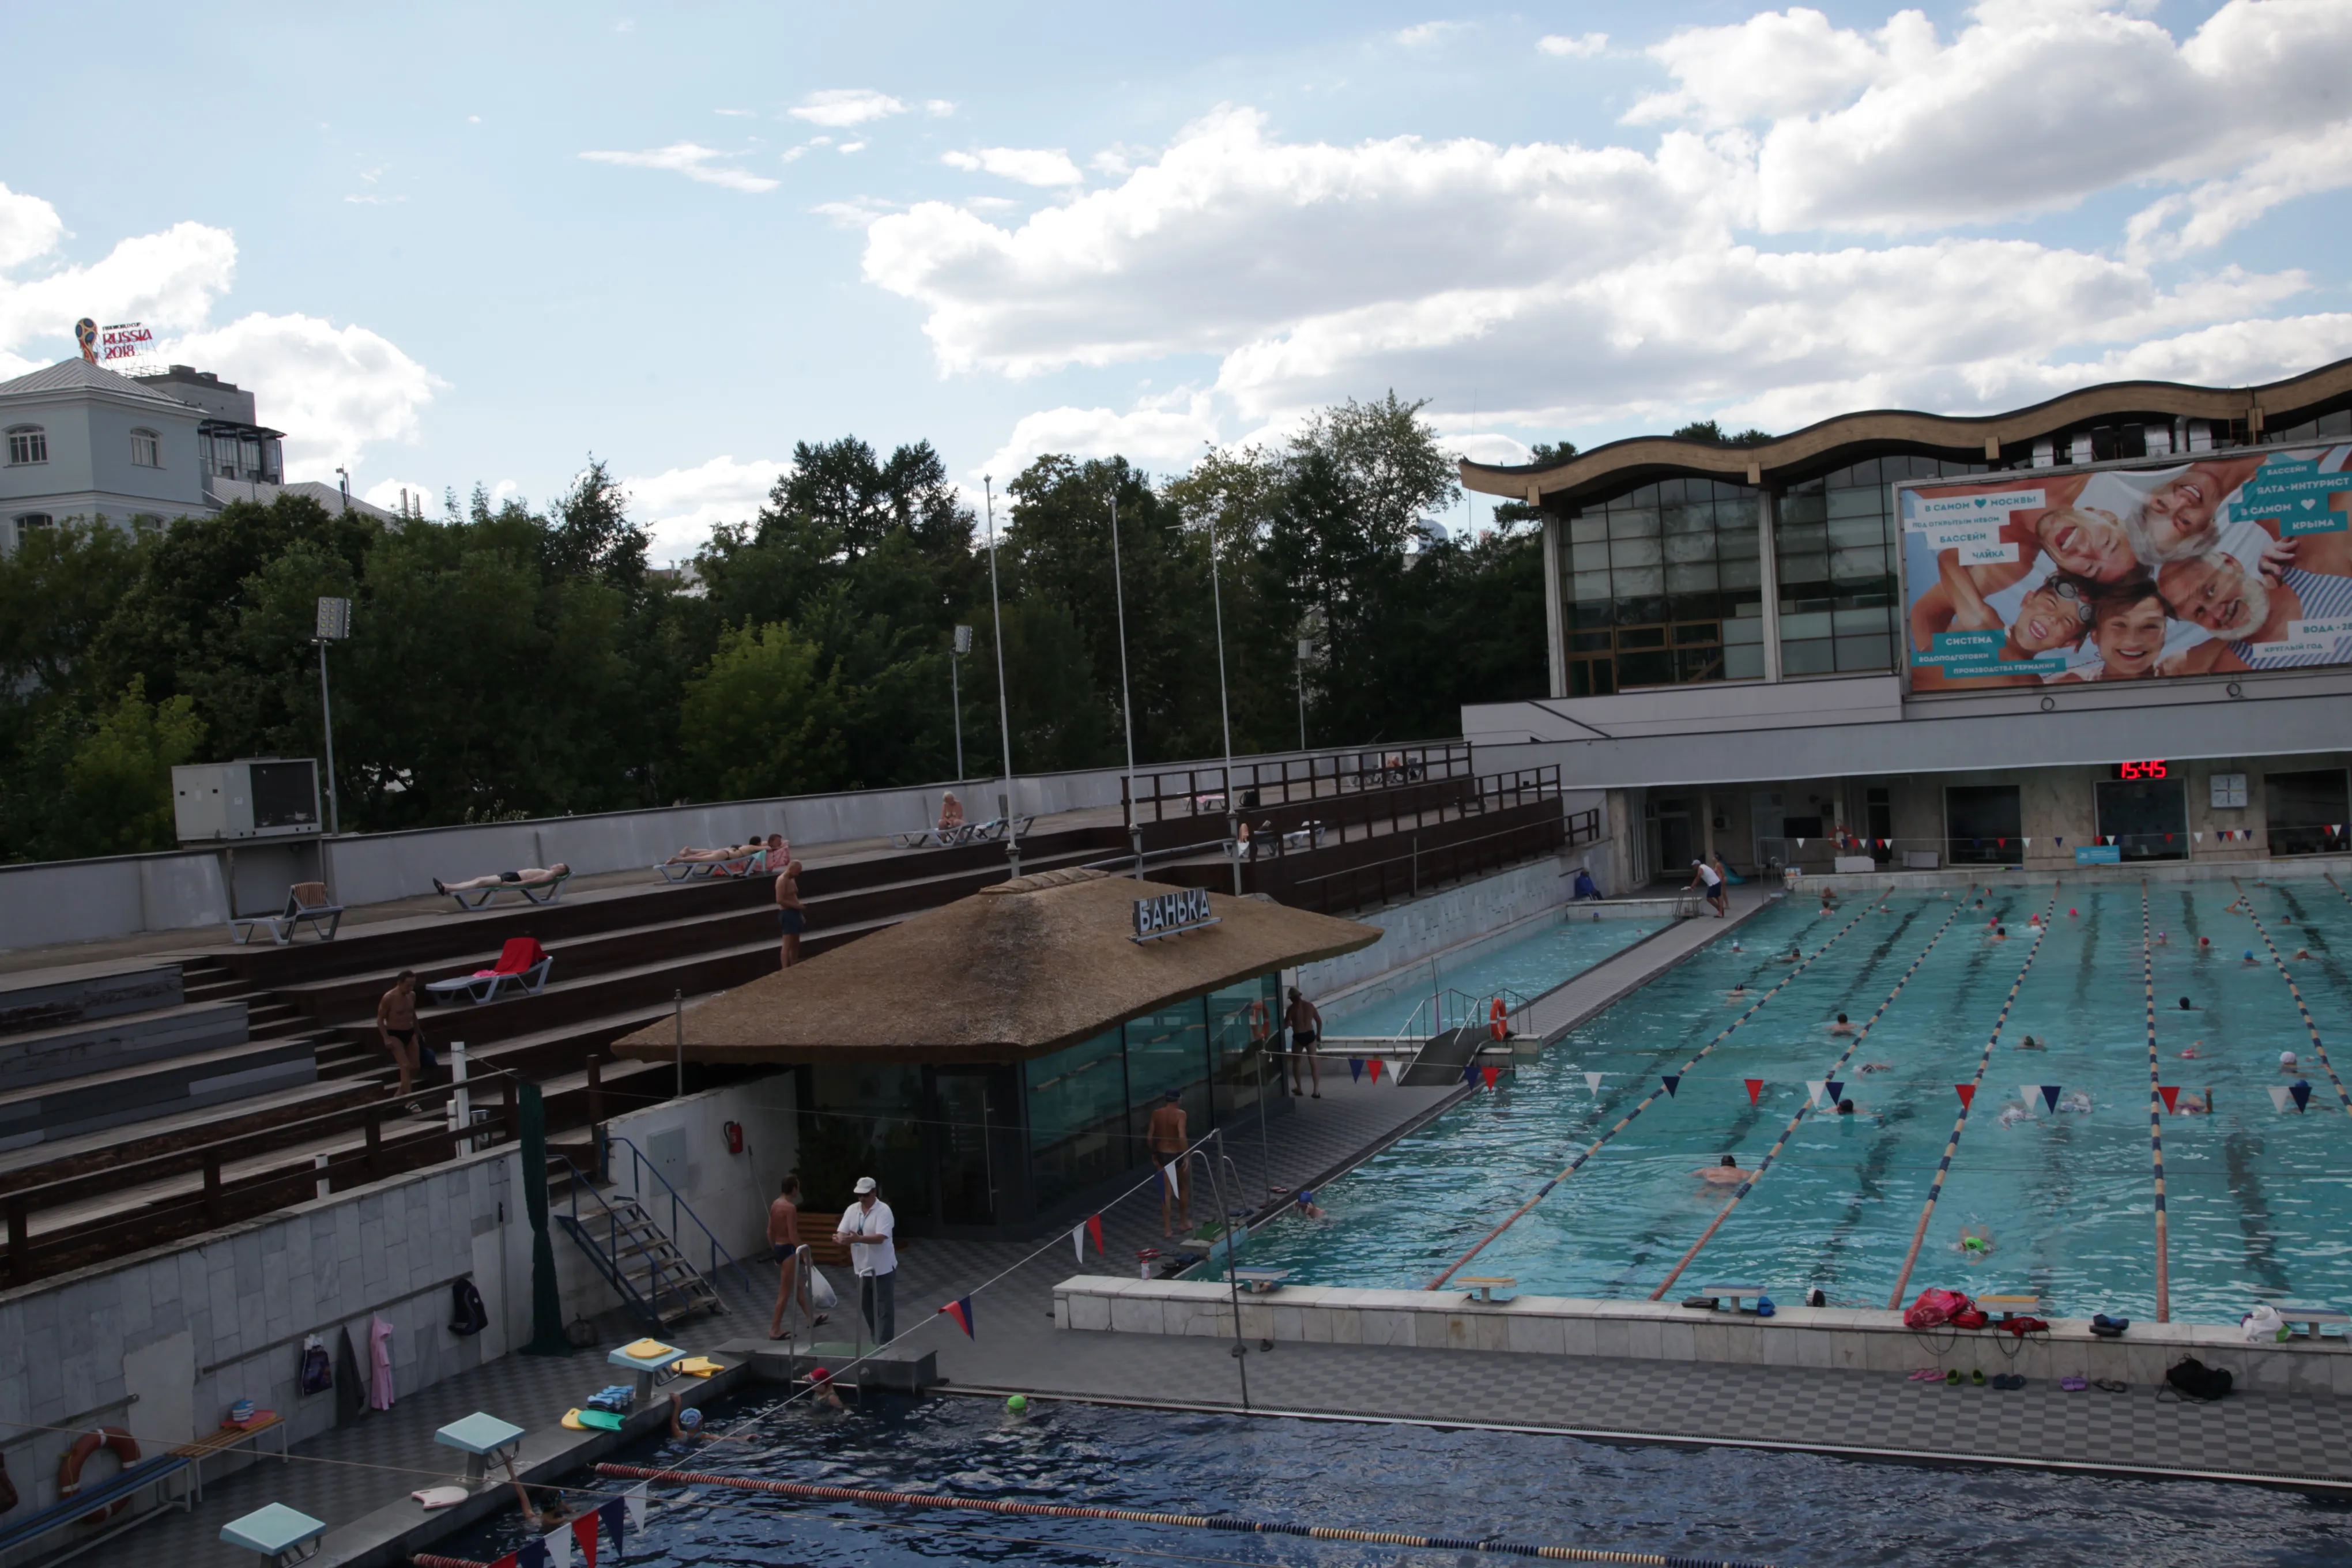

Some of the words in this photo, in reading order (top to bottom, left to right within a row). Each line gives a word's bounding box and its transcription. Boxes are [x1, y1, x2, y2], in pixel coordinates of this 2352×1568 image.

[103, 329, 153, 345] RUSSIA
[105, 345, 135, 359] 2018
[2267, 465, 2308, 476] БАССЕЙН
[2257, 477, 2350, 495] ЯЛТА-ИНТУРИСТ
[1933, 502, 1970, 511] САМОМ
[1990, 496, 2037, 507] МОСКВЫ
[2241, 508, 2248, 516] В
[2250, 503, 2292, 515] САМОМ
[1929, 519, 1972, 527] ОТКРЫТЫМ
[2292, 518, 2335, 530] КРЫМА
[1939, 532, 1987, 543] БАССЕЙН
[1972, 549, 2005, 559] ЧАЙКА
[2303, 624, 2334, 634] ВОДА
[1945, 636, 1993, 646] СИСТЕМА
[2264, 643, 2304, 653] КРУГЛЫЙ
[1918, 653, 1989, 662] ВОДОПОДГОТОВКИ
[1953, 665, 2013, 674] ПРОИЗВОДСТВА
[2014, 662, 2056, 671] ГЕРМАНИИ
[2121, 760, 2167, 779] 15:45
[1138, 887, 1212, 932] БАНЬКА
